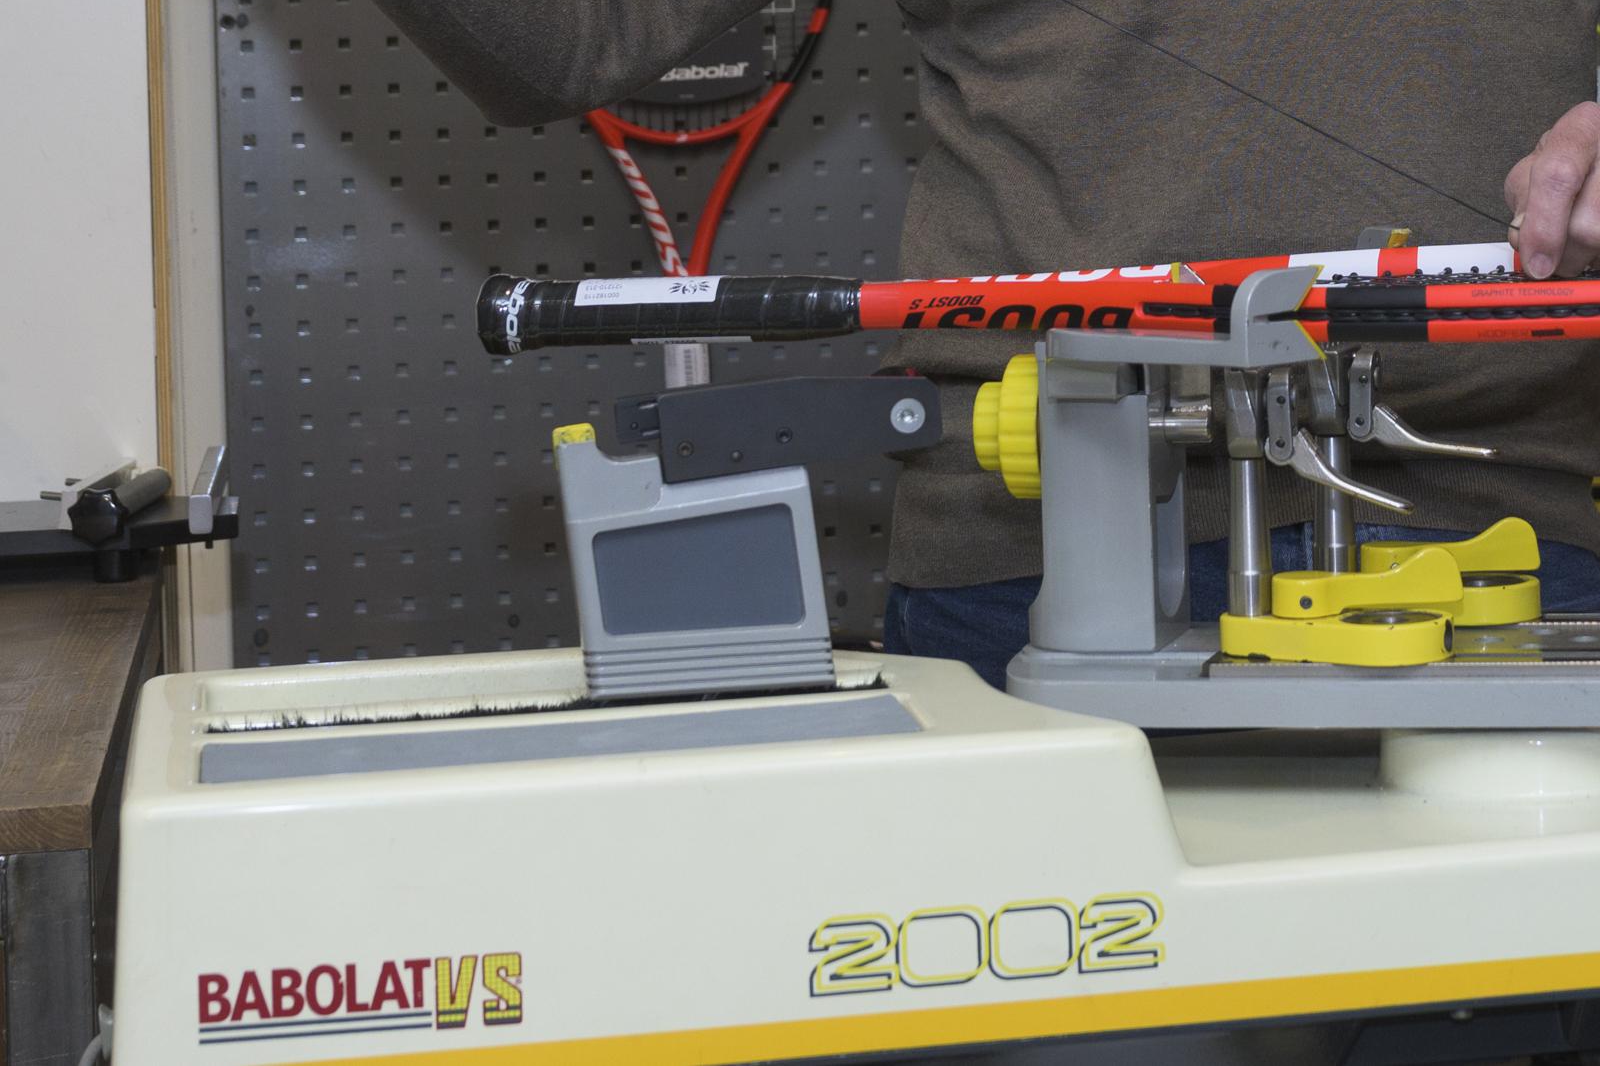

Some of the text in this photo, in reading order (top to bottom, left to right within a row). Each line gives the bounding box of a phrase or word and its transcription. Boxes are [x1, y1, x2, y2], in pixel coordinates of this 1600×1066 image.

[909, 295, 984, 310] BOOST S
[1472, 287, 1575, 298] GRAPHITE TECHNOLOGY
[808, 891, 1166, 997] 2002
[198, 951, 523, 1030] BABOLAT VS
